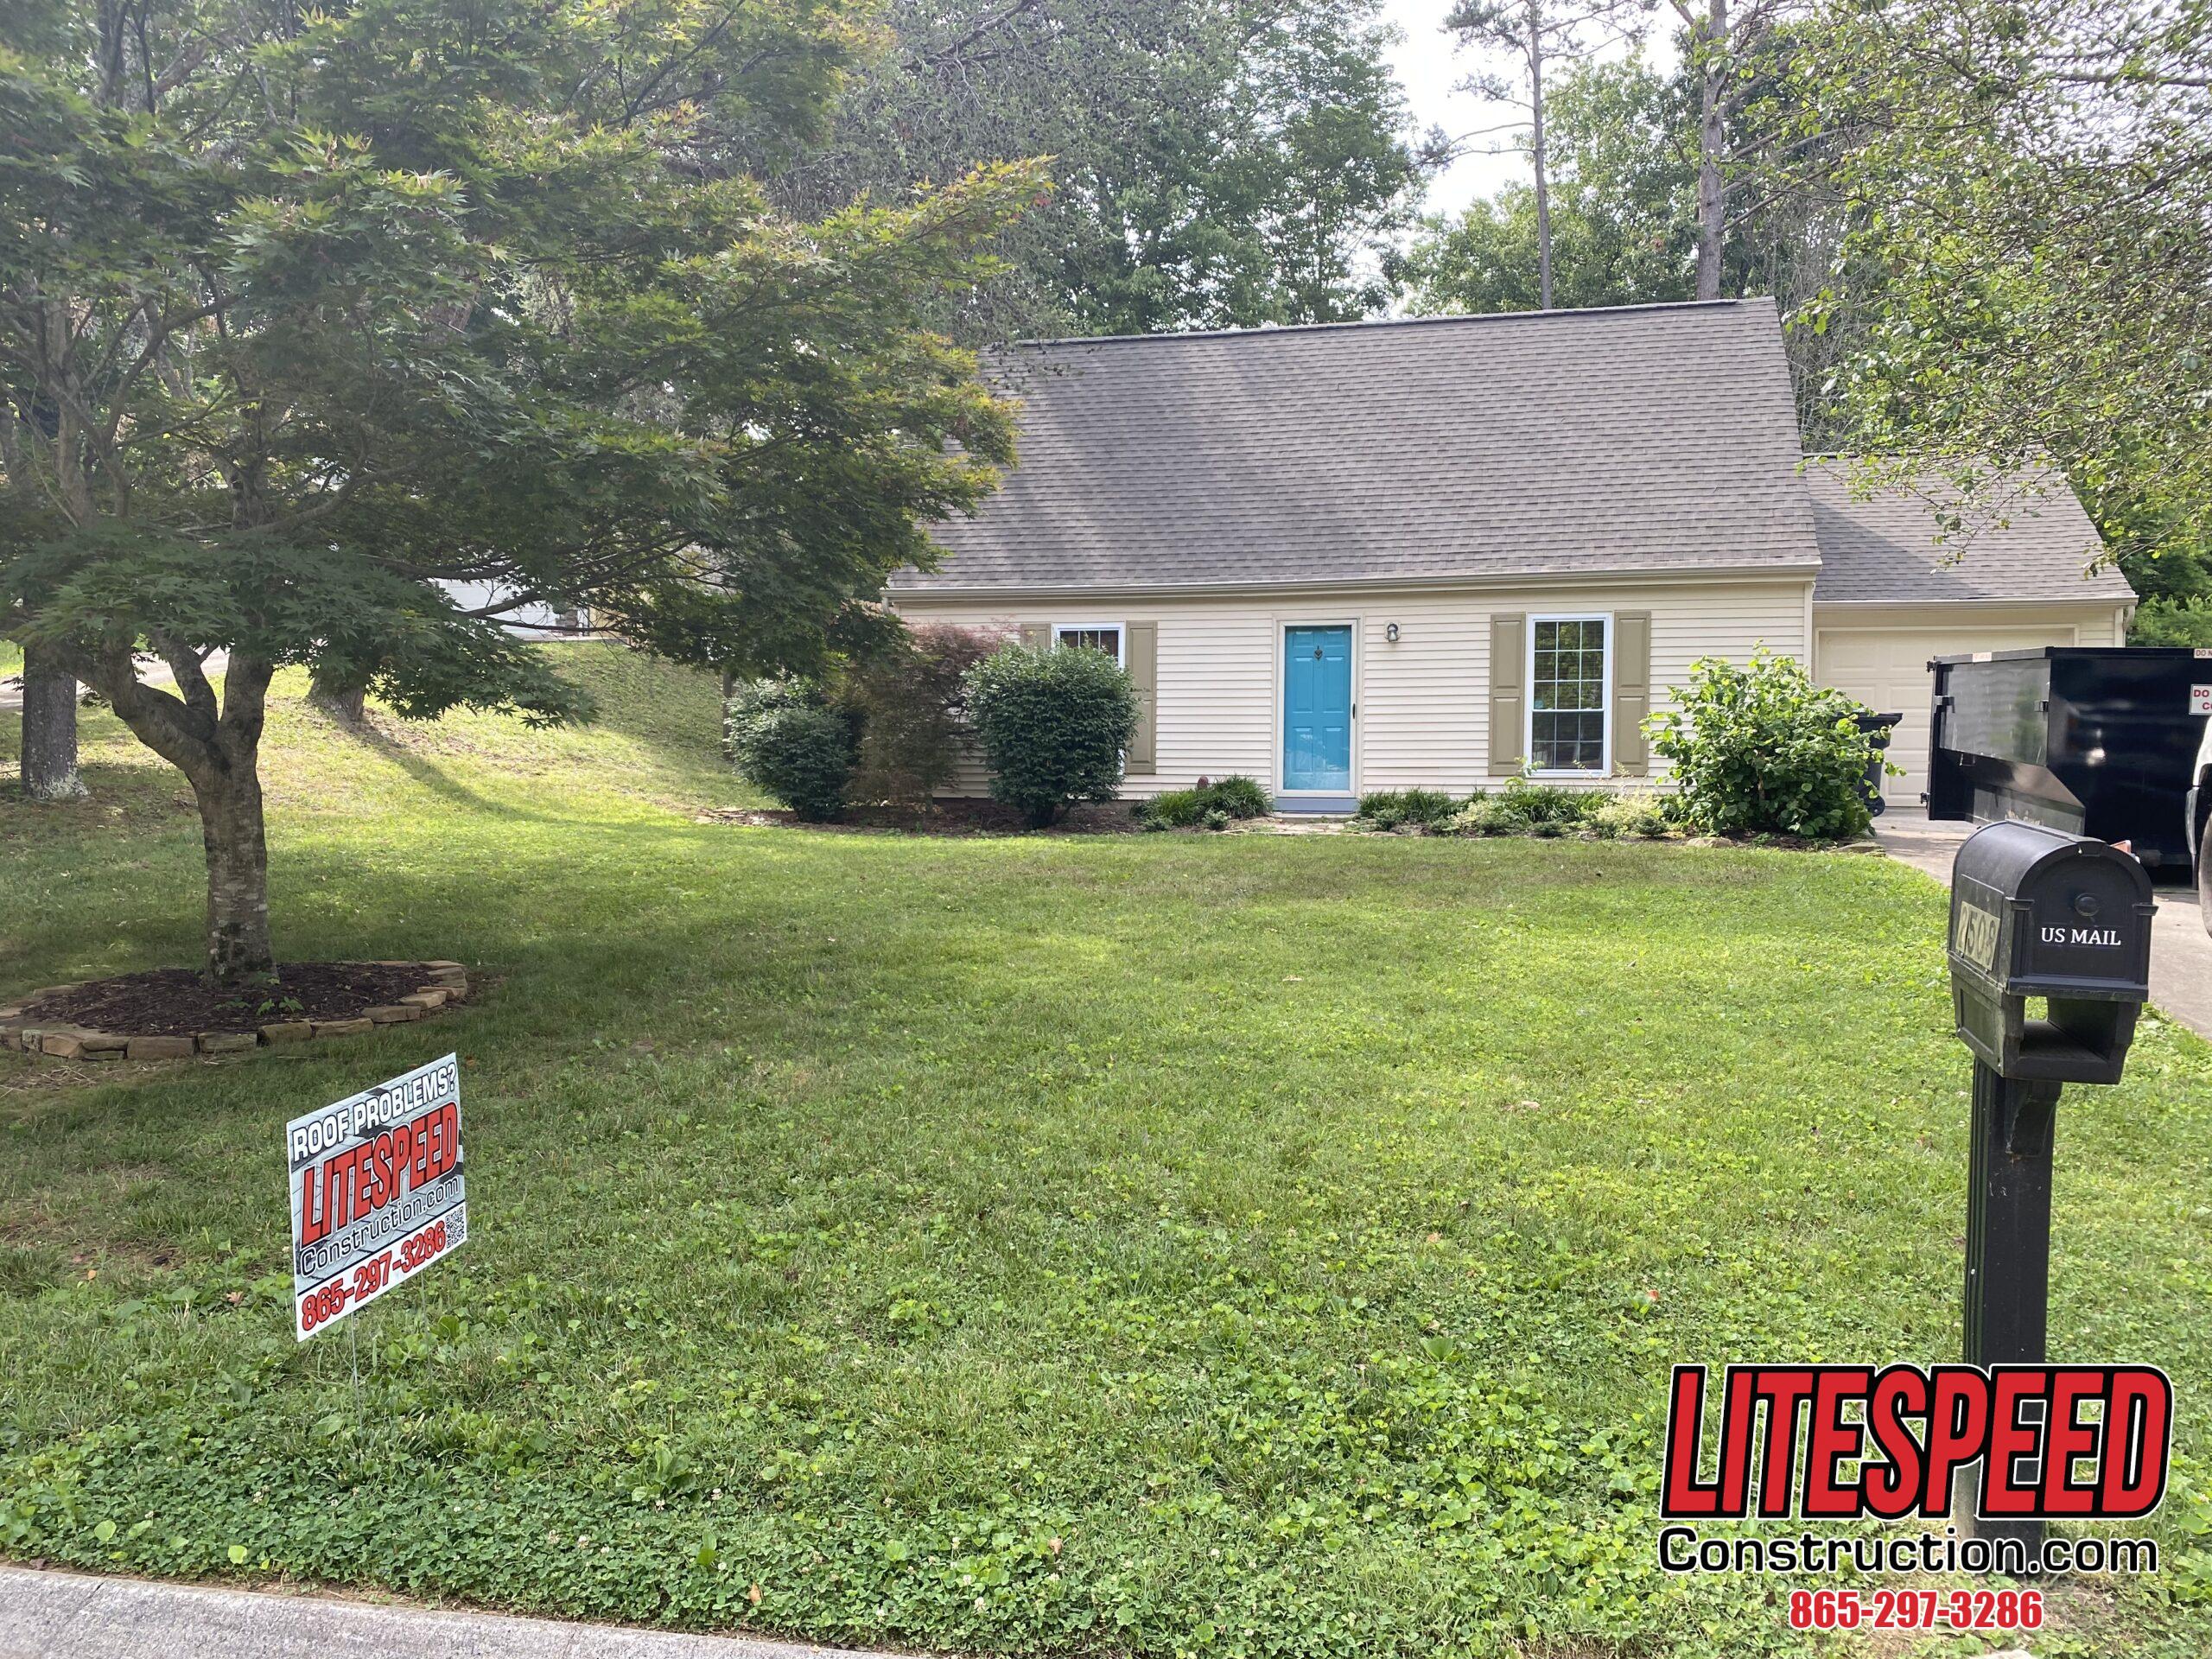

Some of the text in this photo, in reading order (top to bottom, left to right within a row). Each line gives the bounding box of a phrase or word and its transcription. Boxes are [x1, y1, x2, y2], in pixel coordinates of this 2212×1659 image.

[2193, 689, 2209, 698] DO
[2041, 927, 2121, 946] US MAIL
[293, 1062, 457, 1162] ROOF PROBLEMS?
[302, 1102, 459, 1249] LITESPEED
[302, 1176, 460, 1277] Construction.com
[302, 1220, 447, 1332] 865-297-3286
